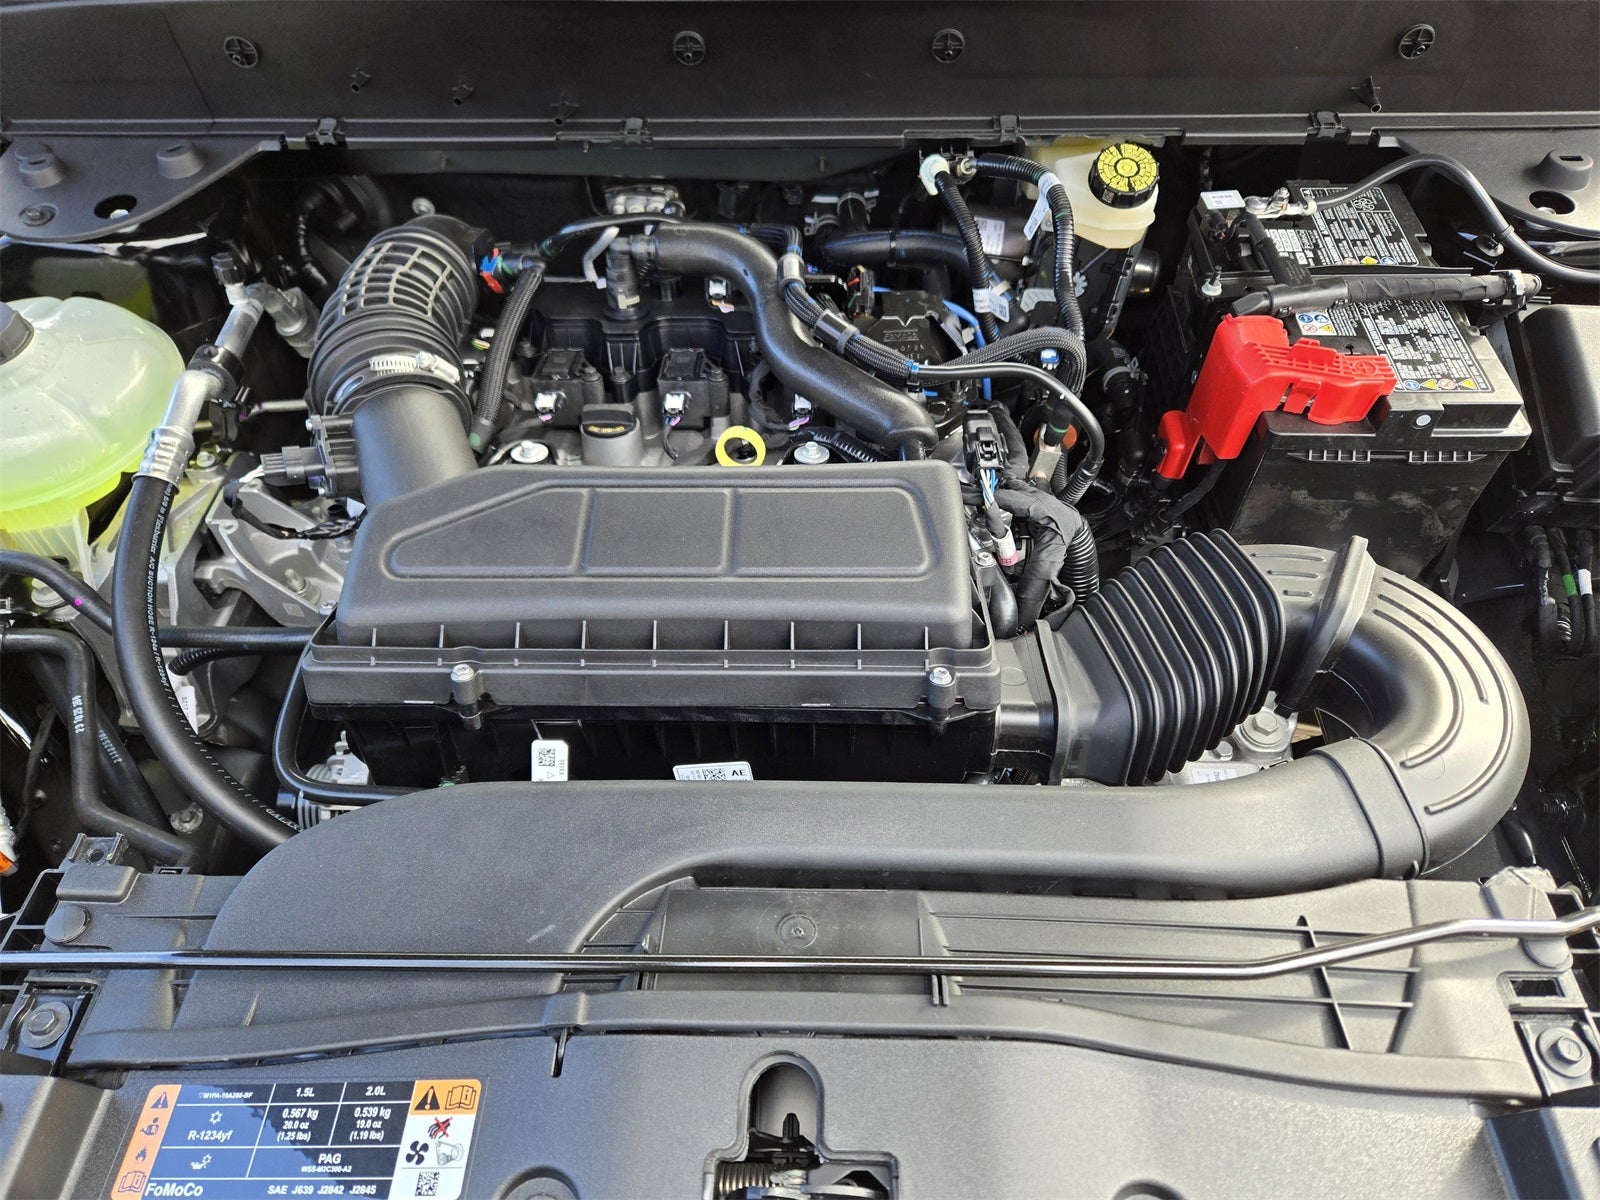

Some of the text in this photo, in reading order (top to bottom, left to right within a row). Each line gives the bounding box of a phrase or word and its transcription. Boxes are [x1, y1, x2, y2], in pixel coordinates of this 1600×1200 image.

[147, 571, 155, 604] SUCTION
[296, 1087, 315, 1097] 1.5L
[365, 1086, 386, 1096] 2.0L
[282, 1108, 319, 1120] 0.567 kg
[354, 1107, 391, 1119] 0.539 kg
[283, 1121, 299, 1130] 20.0
[356, 1120, 371, 1129] 19.0
[187, 1130, 233, 1143] R-1234yf
[277, 1131, 311, 1142] (1.25 lbs)
[350, 1131, 384, 1141] (1.19 lbs)
[318, 1154, 341, 1164] PAG
[144, 1183, 203, 1197] FoMoCo
[267, 1185, 377, 1195] SAE J639 J2842 J2845
